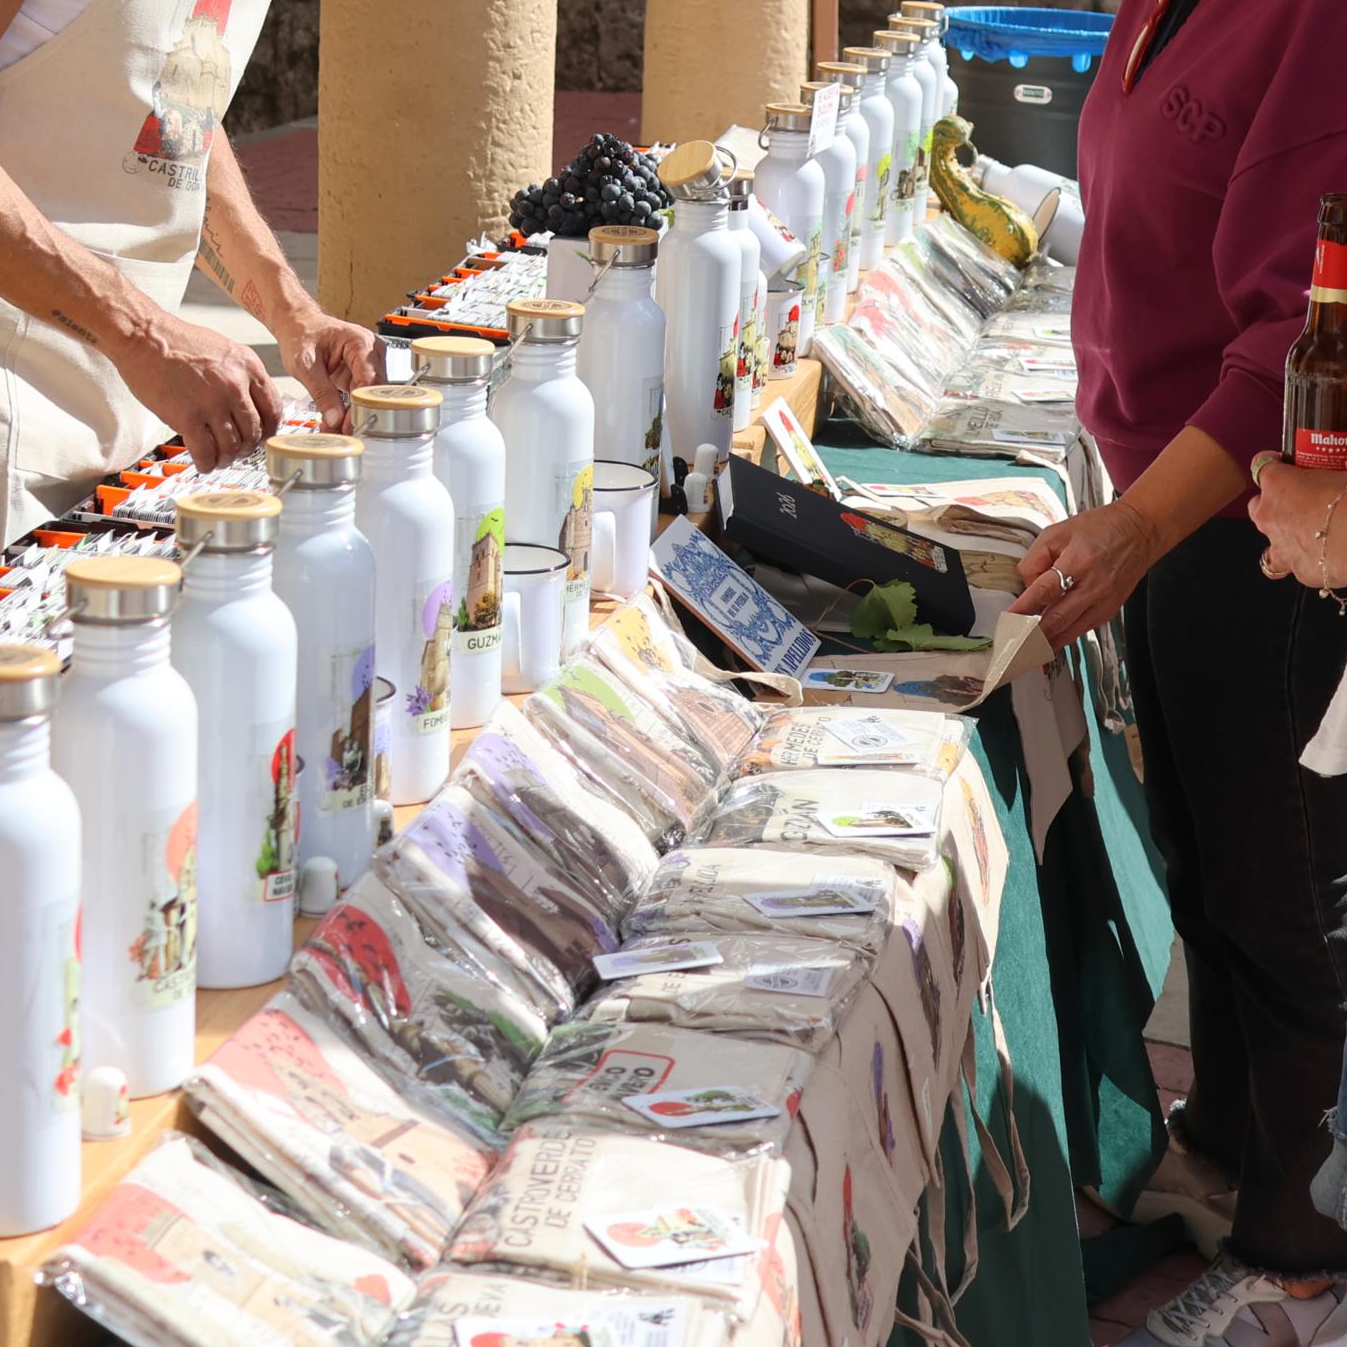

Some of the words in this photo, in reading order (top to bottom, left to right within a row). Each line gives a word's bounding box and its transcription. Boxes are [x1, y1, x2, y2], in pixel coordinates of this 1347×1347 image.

[167, 177, 184, 189] DE
[781, 628, 817, 673] APELLIDOS
[504, 1127, 573, 1249] CASTROVERDE
[555, 1137, 597, 1204] CERRATO
[544, 1207, 572, 1229] DE
